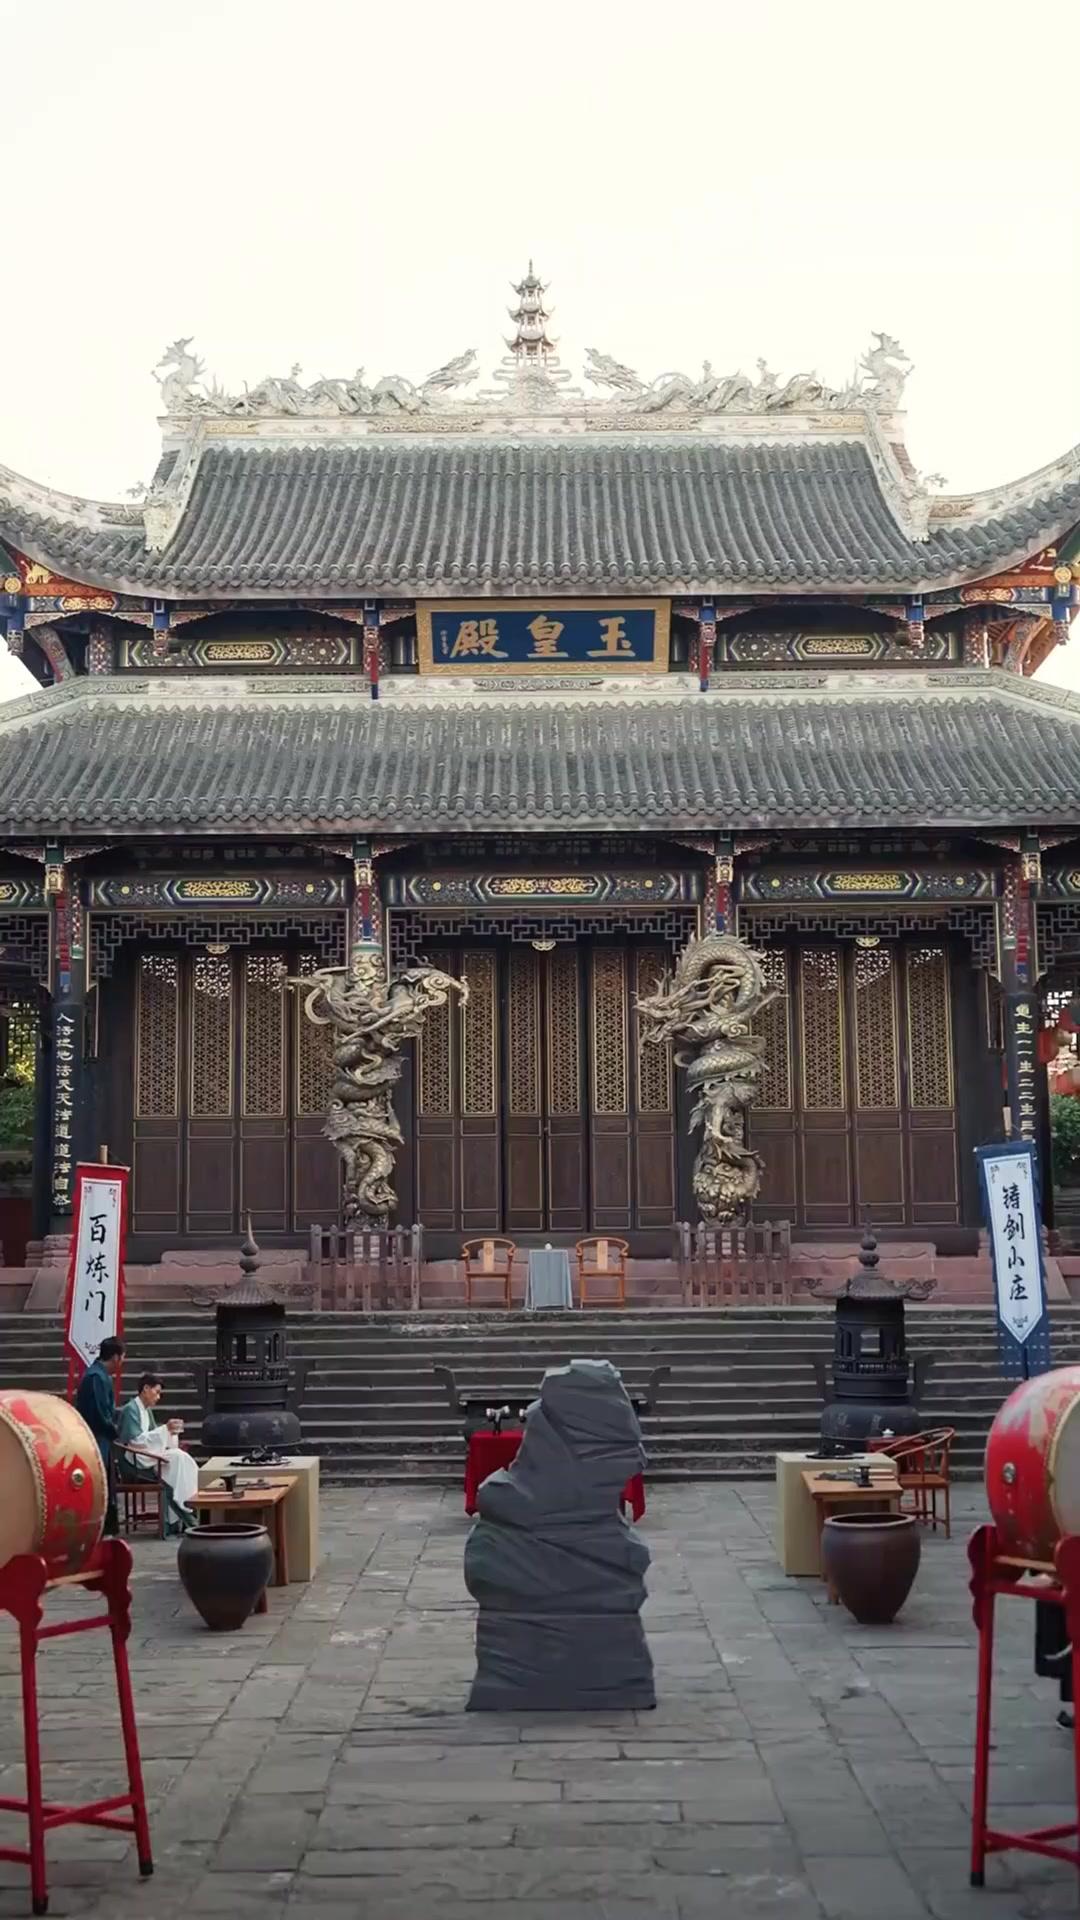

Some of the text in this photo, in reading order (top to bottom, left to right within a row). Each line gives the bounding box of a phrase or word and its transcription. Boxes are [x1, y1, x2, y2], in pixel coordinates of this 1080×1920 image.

[450, 614, 635, 658] 玉皇殿
[84, 1214, 109, 1322] 百炼门
